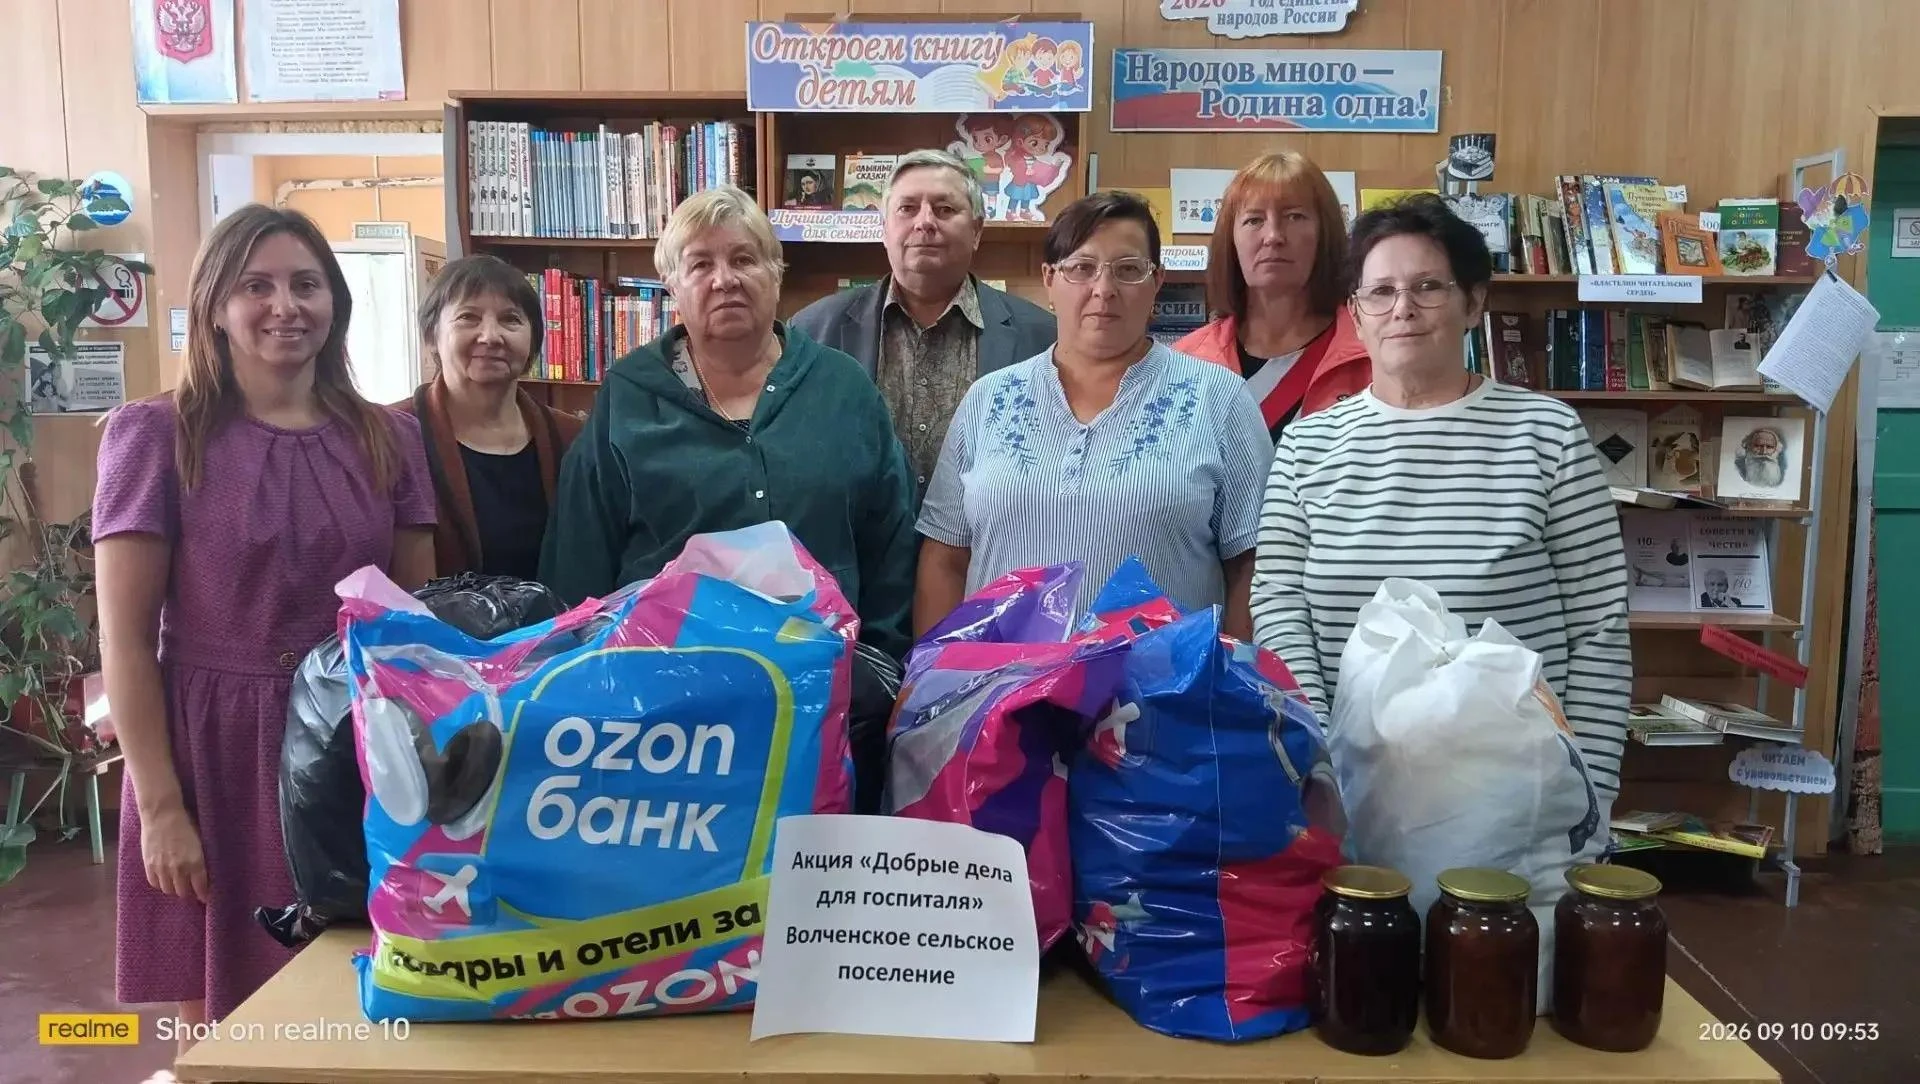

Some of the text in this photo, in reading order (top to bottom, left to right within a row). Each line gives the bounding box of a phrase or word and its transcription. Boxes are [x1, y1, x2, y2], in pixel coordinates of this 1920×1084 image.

[1217, 9, 1337, 29] народов России
[755, 25, 1003, 69] Откроем книгу
[1125, 53, 1255, 90] Народов
[1264, 60, 1357, 83] много
[799, 64, 916, 105] детям
[1199, 88, 1428, 120] Родина одна!
[1667, 190, 1685, 200] 245
[772, 210, 879, 227] Лучшие книги
[804, 226, 883, 240] для семейно
[1163, 257, 1205, 268] Россию!
[1590, 279, 1636, 287] «ВЛАСТЕЛИН
[544, 716, 736, 776] ozon
[1762, 752, 1806, 766] ЧИТАЕМ
[526, 775, 726, 853] банк
[792, 851, 1013, 883] Акция «Добрые дела
[816, 889, 983, 910] для госпиталя»
[537, 949, 565, 974] и
[577, 918, 702, 966] отели
[714, 902, 762, 934] за
[786, 926, 1015, 951] Волченское сельское
[563, 950, 762, 1018] OZON
[838, 964, 955, 985] поселение
